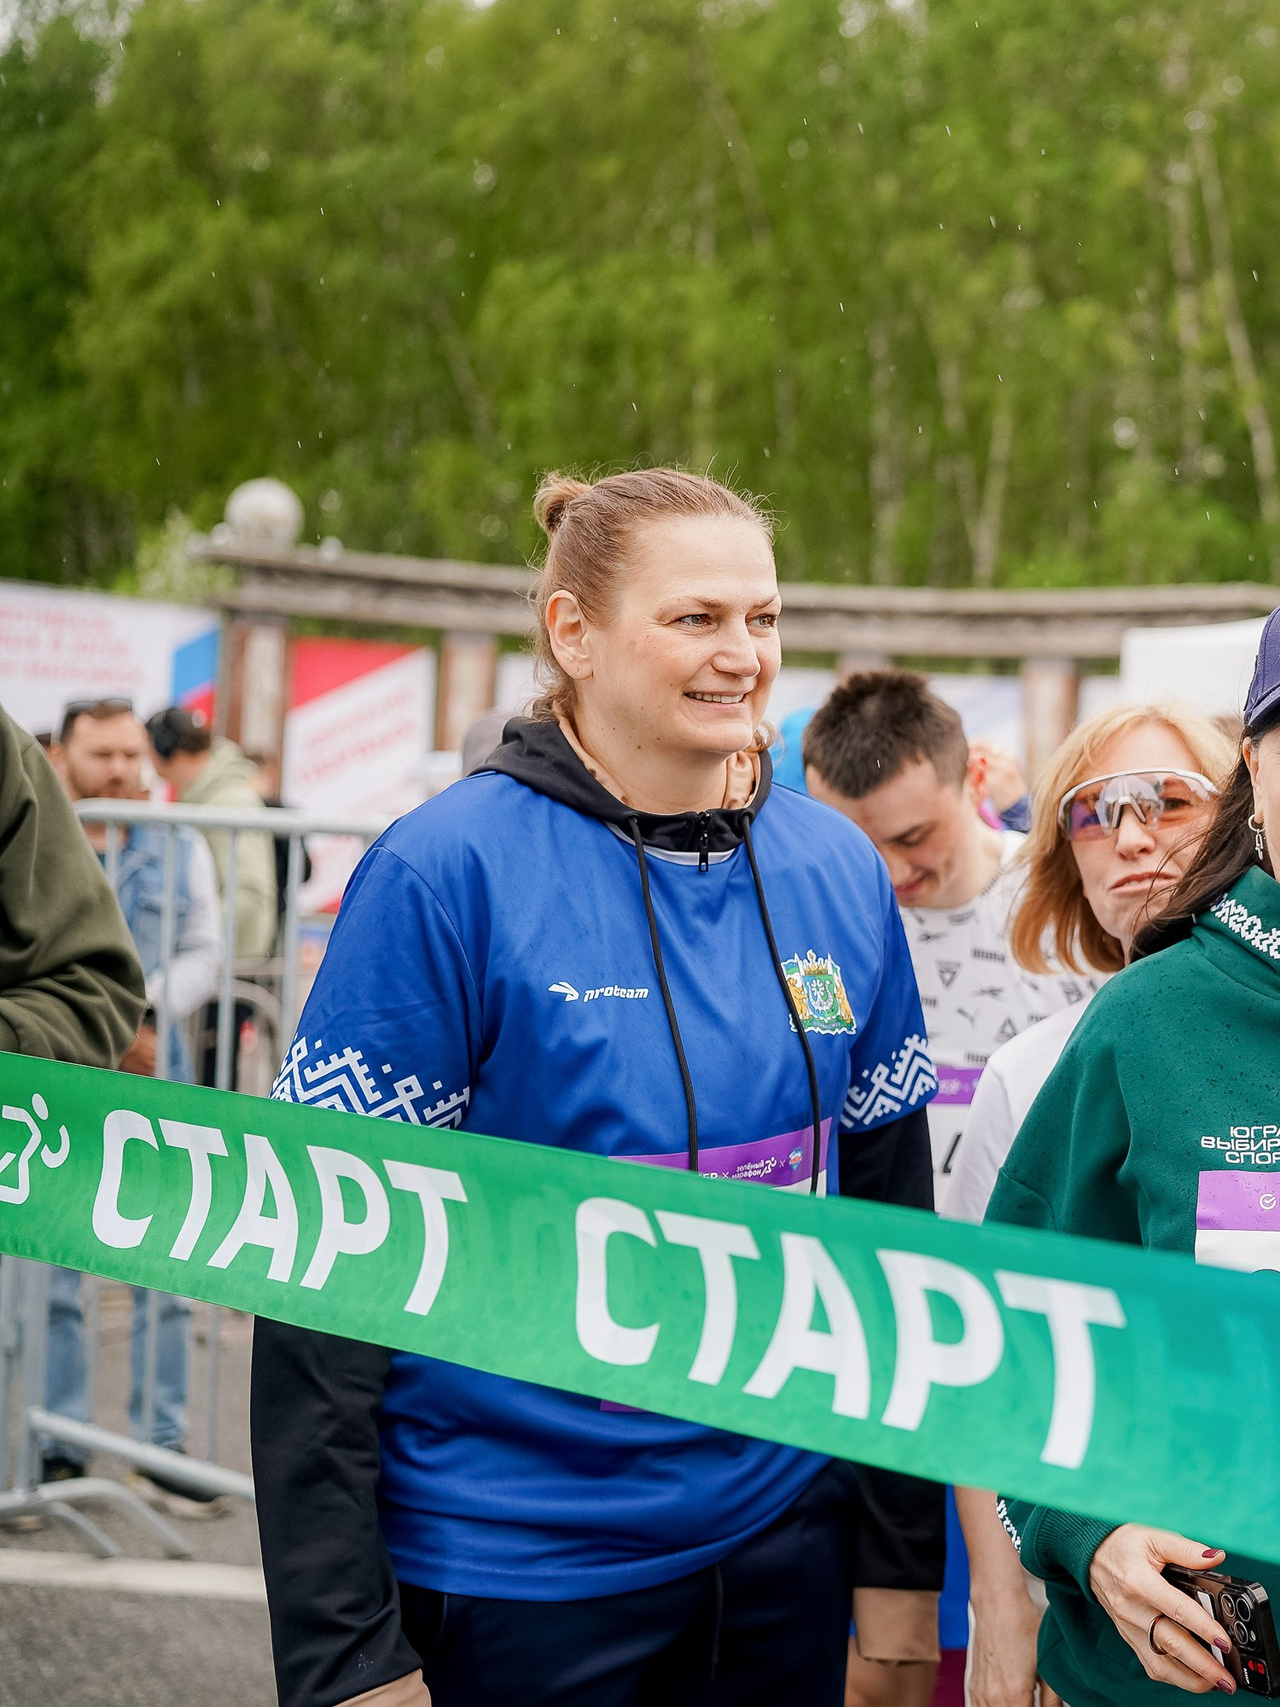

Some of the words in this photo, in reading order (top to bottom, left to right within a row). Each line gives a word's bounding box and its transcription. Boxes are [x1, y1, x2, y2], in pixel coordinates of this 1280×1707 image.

[583, 985, 649, 1002] proteam
[736, 1160, 765, 1172] зелёный
[92, 1109, 468, 1316] СТАРТ
[575, 1197, 1126, 1469] СТАРТ
